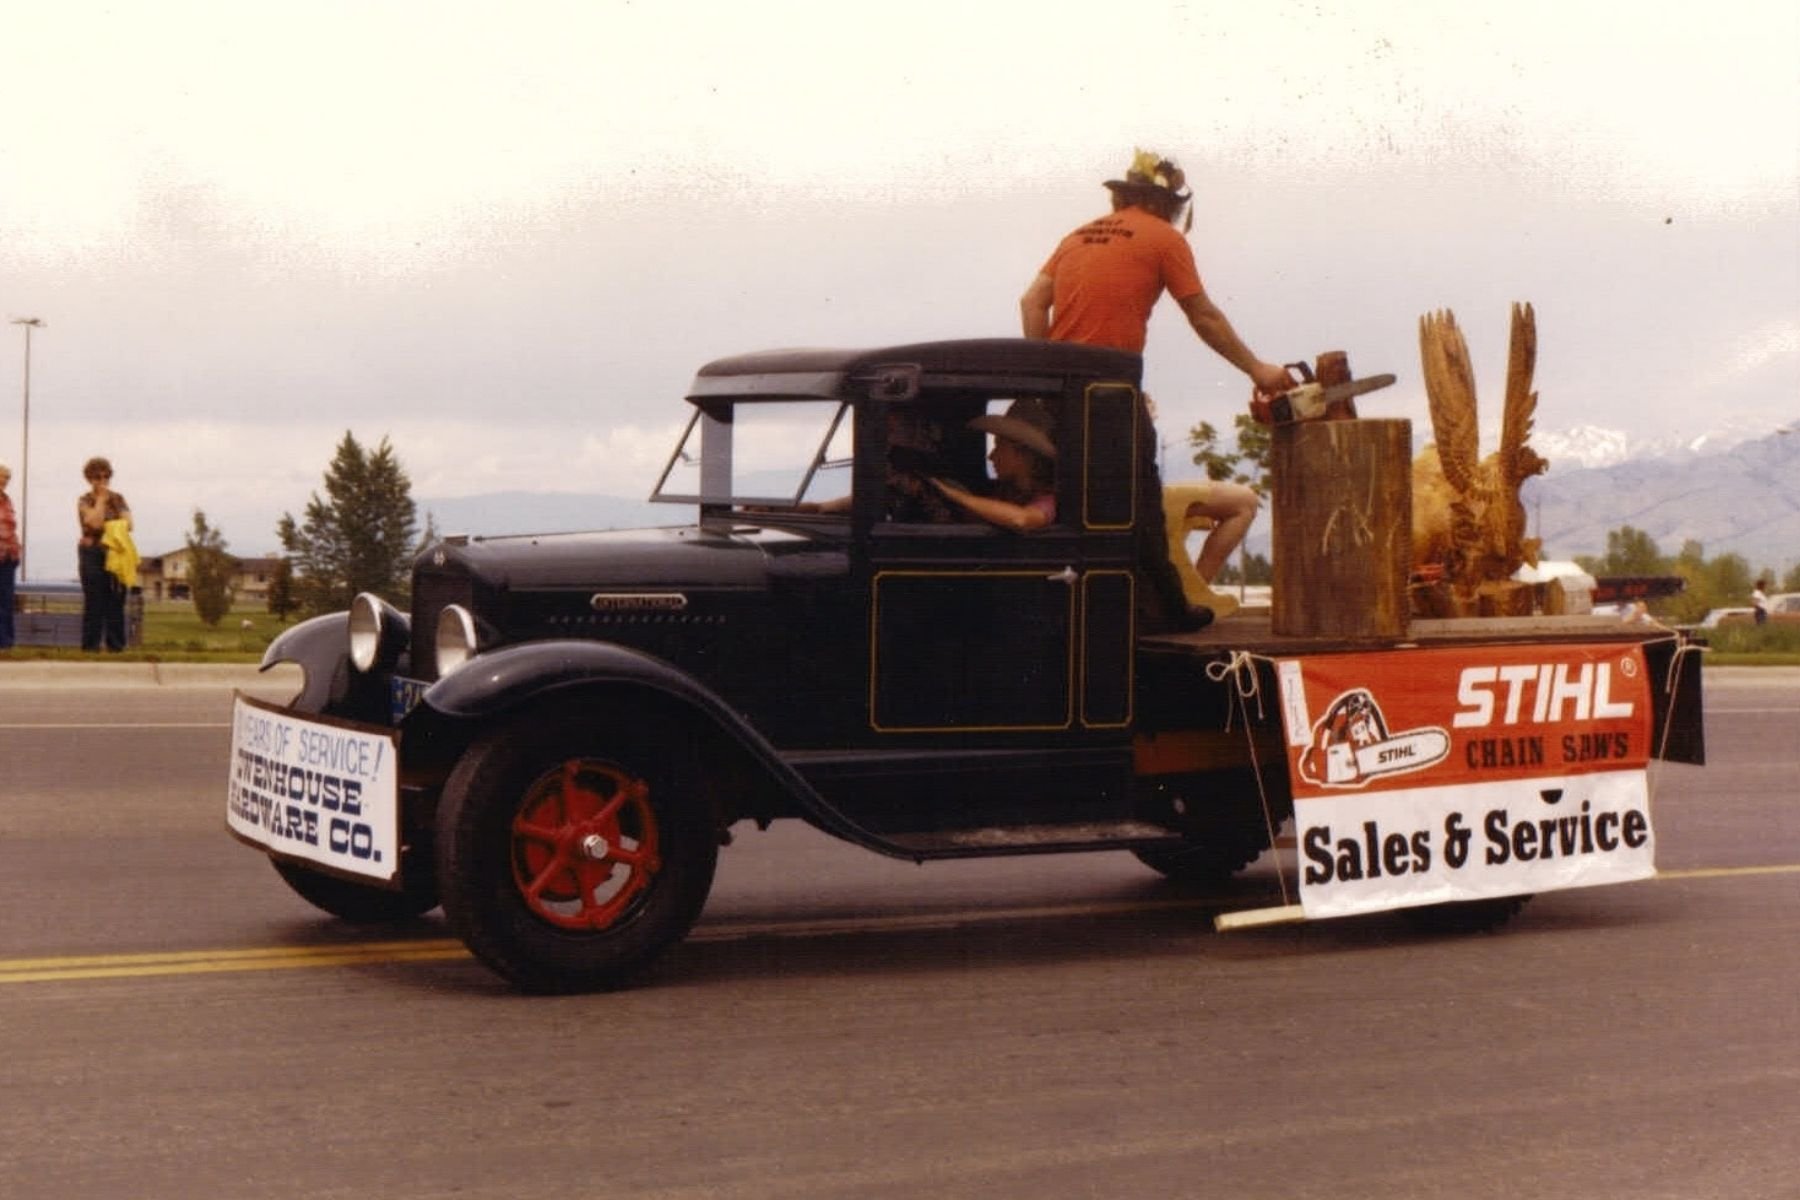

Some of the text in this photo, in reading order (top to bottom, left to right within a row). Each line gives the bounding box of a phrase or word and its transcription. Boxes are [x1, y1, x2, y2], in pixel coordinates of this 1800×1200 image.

[1453, 662, 1634, 728] STIHL
[275, 722, 292, 762] OF
[299, 729, 384, 781] SERVICE!
[1378, 744, 1416, 763] STIHL
[1466, 736, 1545, 769] CHAIN
[330, 817, 382, 863] CO.
[1303, 800, 1648, 886] Sales & Service
